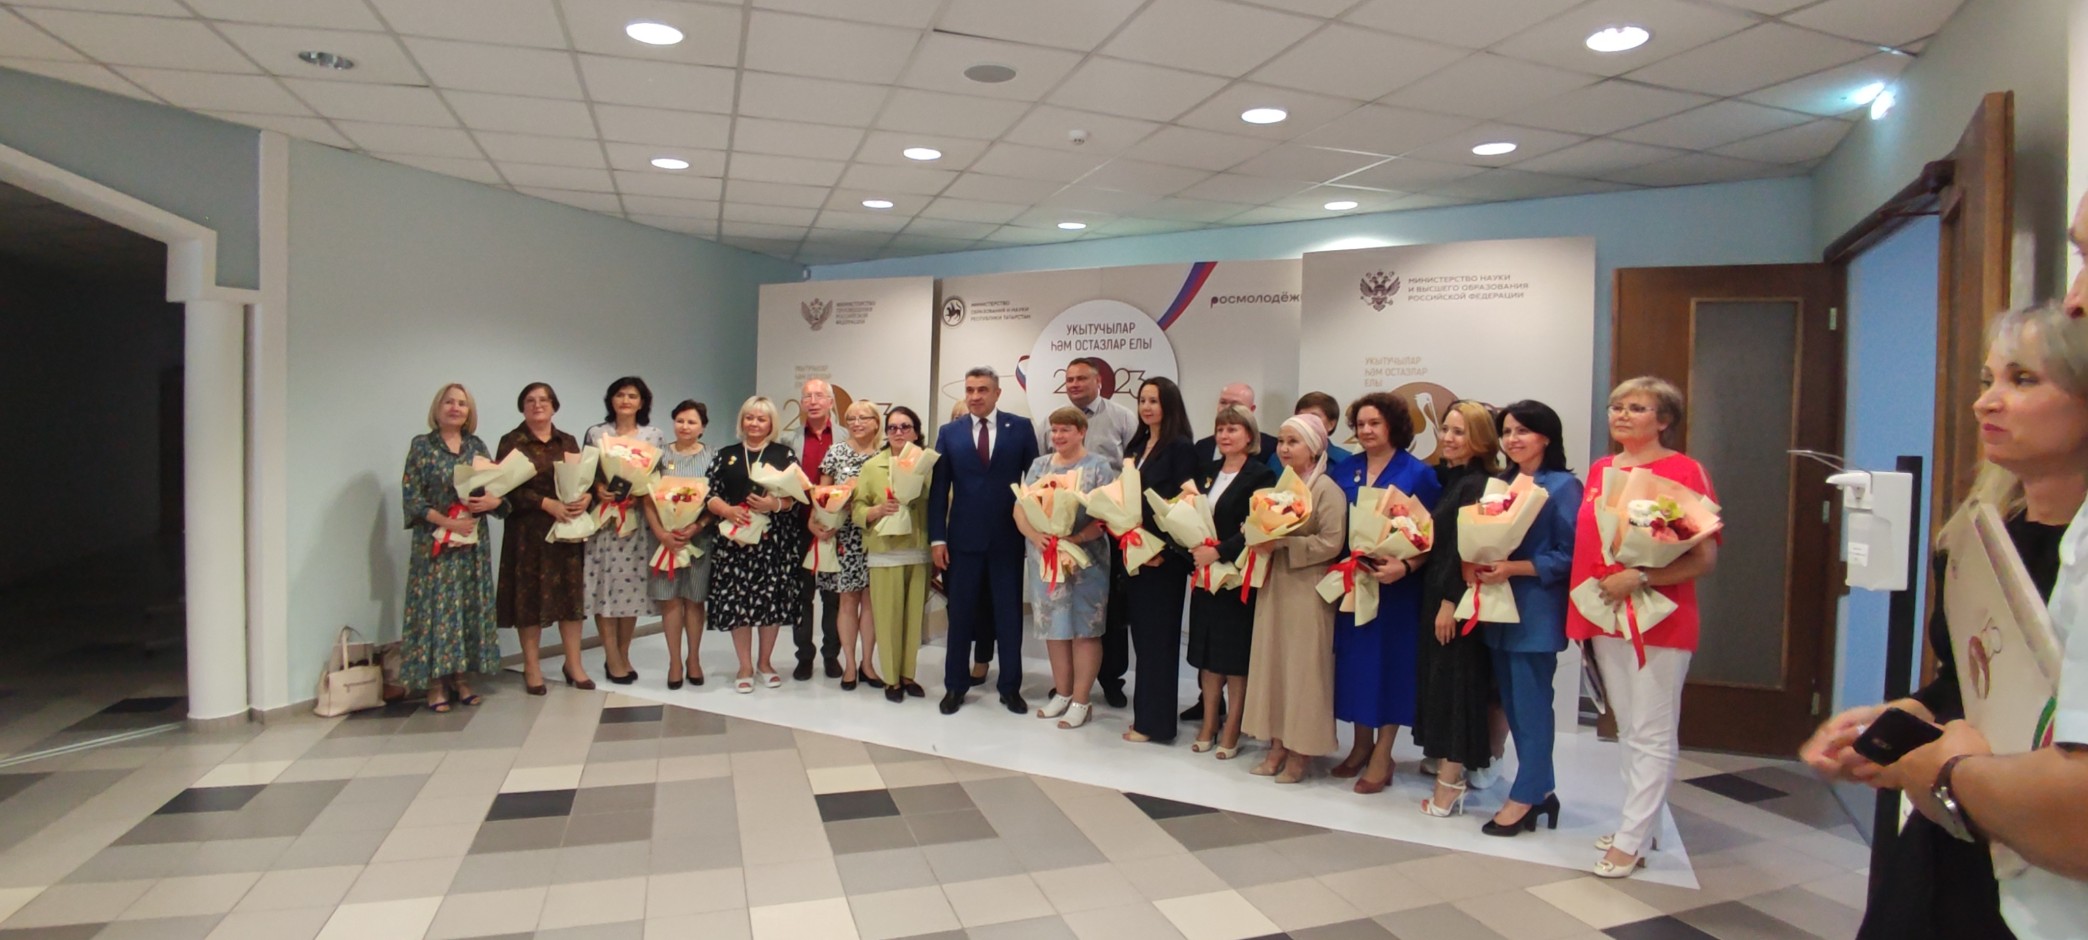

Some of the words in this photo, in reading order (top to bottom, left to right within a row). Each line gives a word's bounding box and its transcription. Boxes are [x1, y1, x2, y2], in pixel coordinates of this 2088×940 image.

[1408, 275, 1478, 284] МИНИСТЕРСТВО
[1480, 274, 1511, 282] НАУКИ
[1416, 285, 1460, 293] ВЫСШЕГО
[1461, 283, 1529, 291] ОБРАЗОВАНИЯ
[1210, 291, 1300, 309] росмолодёж
[1408, 293, 1466, 302] РОССИЙСКОЙ
[1468, 292, 1525, 300] ФЕДЕРАЦИИ
[1066, 322, 1136, 336] УКЫТУЧЫЛАР
[1075, 338, 1127, 351] ОСТАЗЛАР
[1129, 337, 1153, 350] ЕЛЫ
